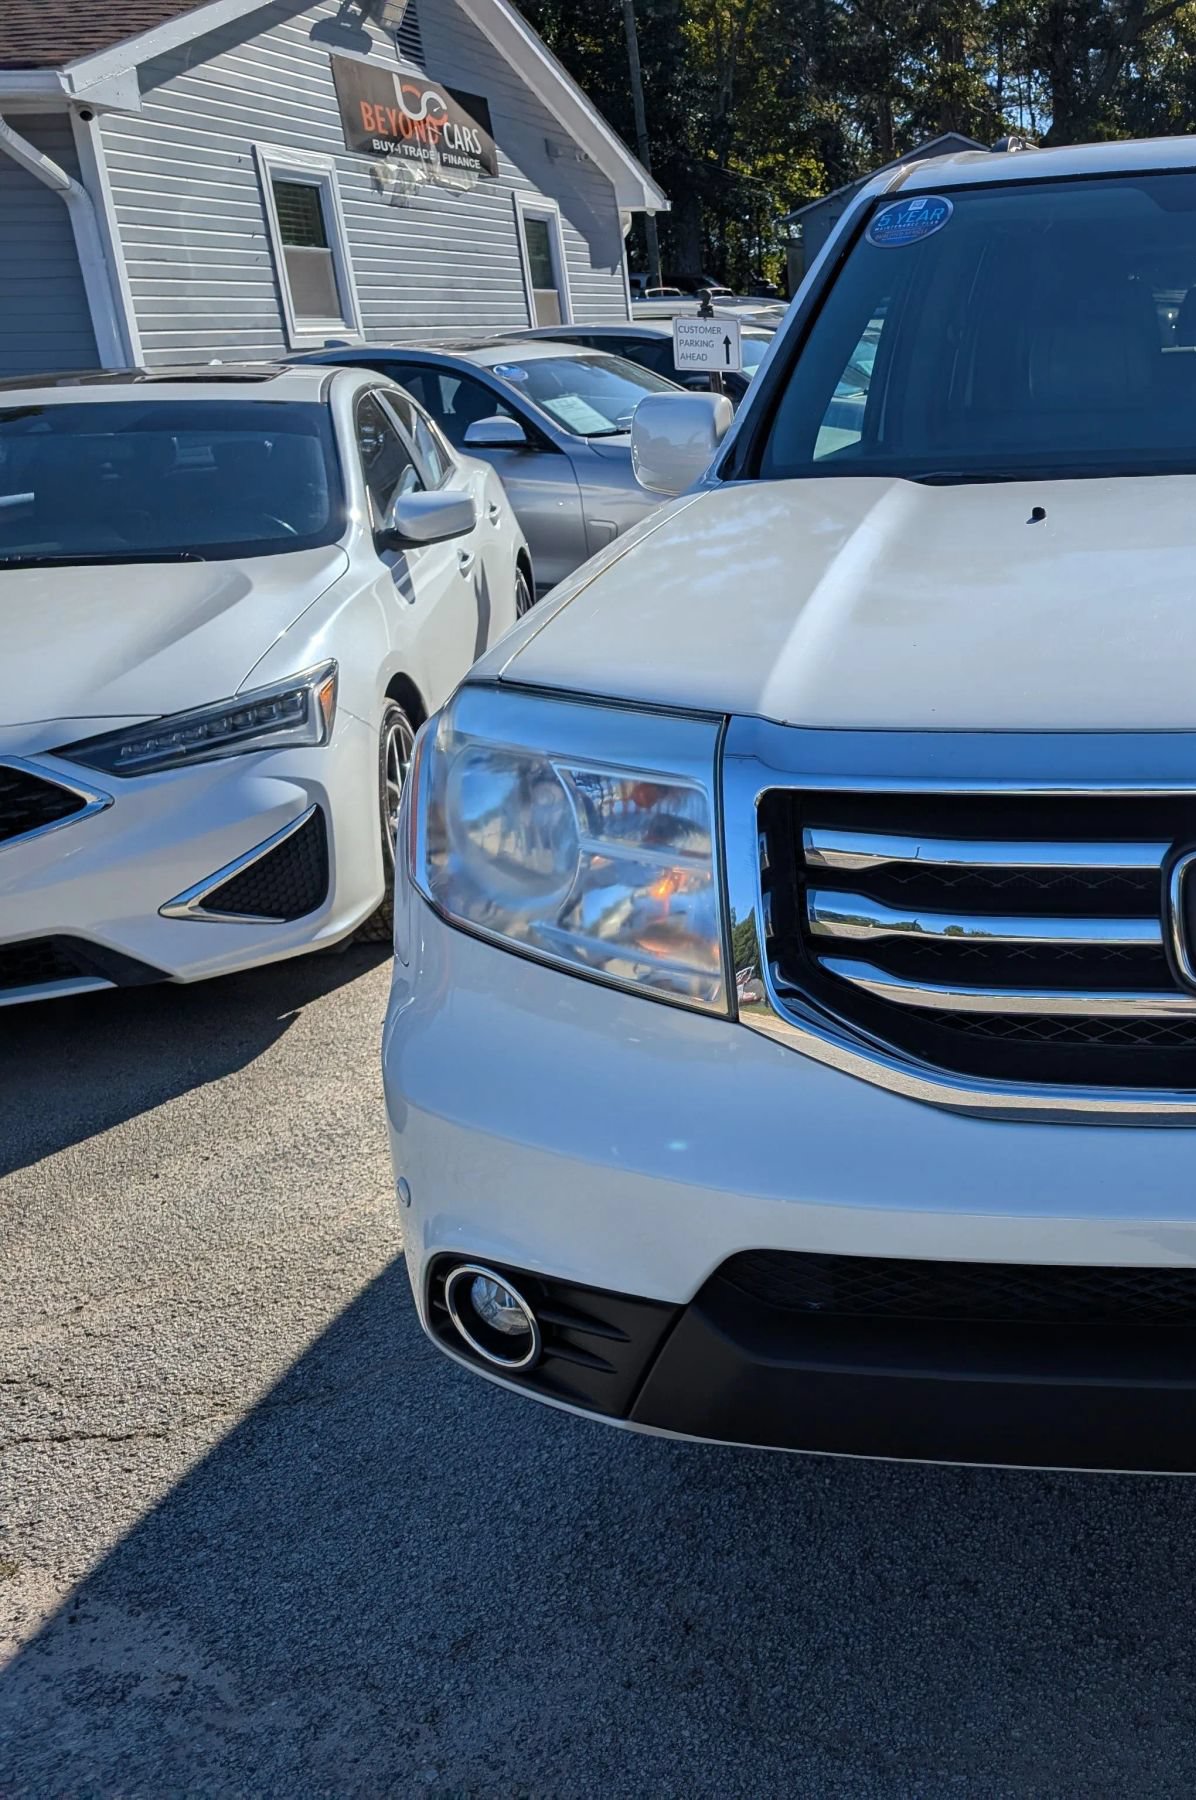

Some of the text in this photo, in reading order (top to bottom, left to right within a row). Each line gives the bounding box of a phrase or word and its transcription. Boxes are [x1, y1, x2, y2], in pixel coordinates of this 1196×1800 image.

[360, 101, 482, 155] BEYOND CARS
[372, 138, 481, 169] BUY TRADE FINANCE
[877, 207, 945, 227] 5 YEAR
[678, 325, 722, 335] CUSTOMER
[679, 339, 715, 349] PARKING
[680, 352, 708, 362] AHEAD
